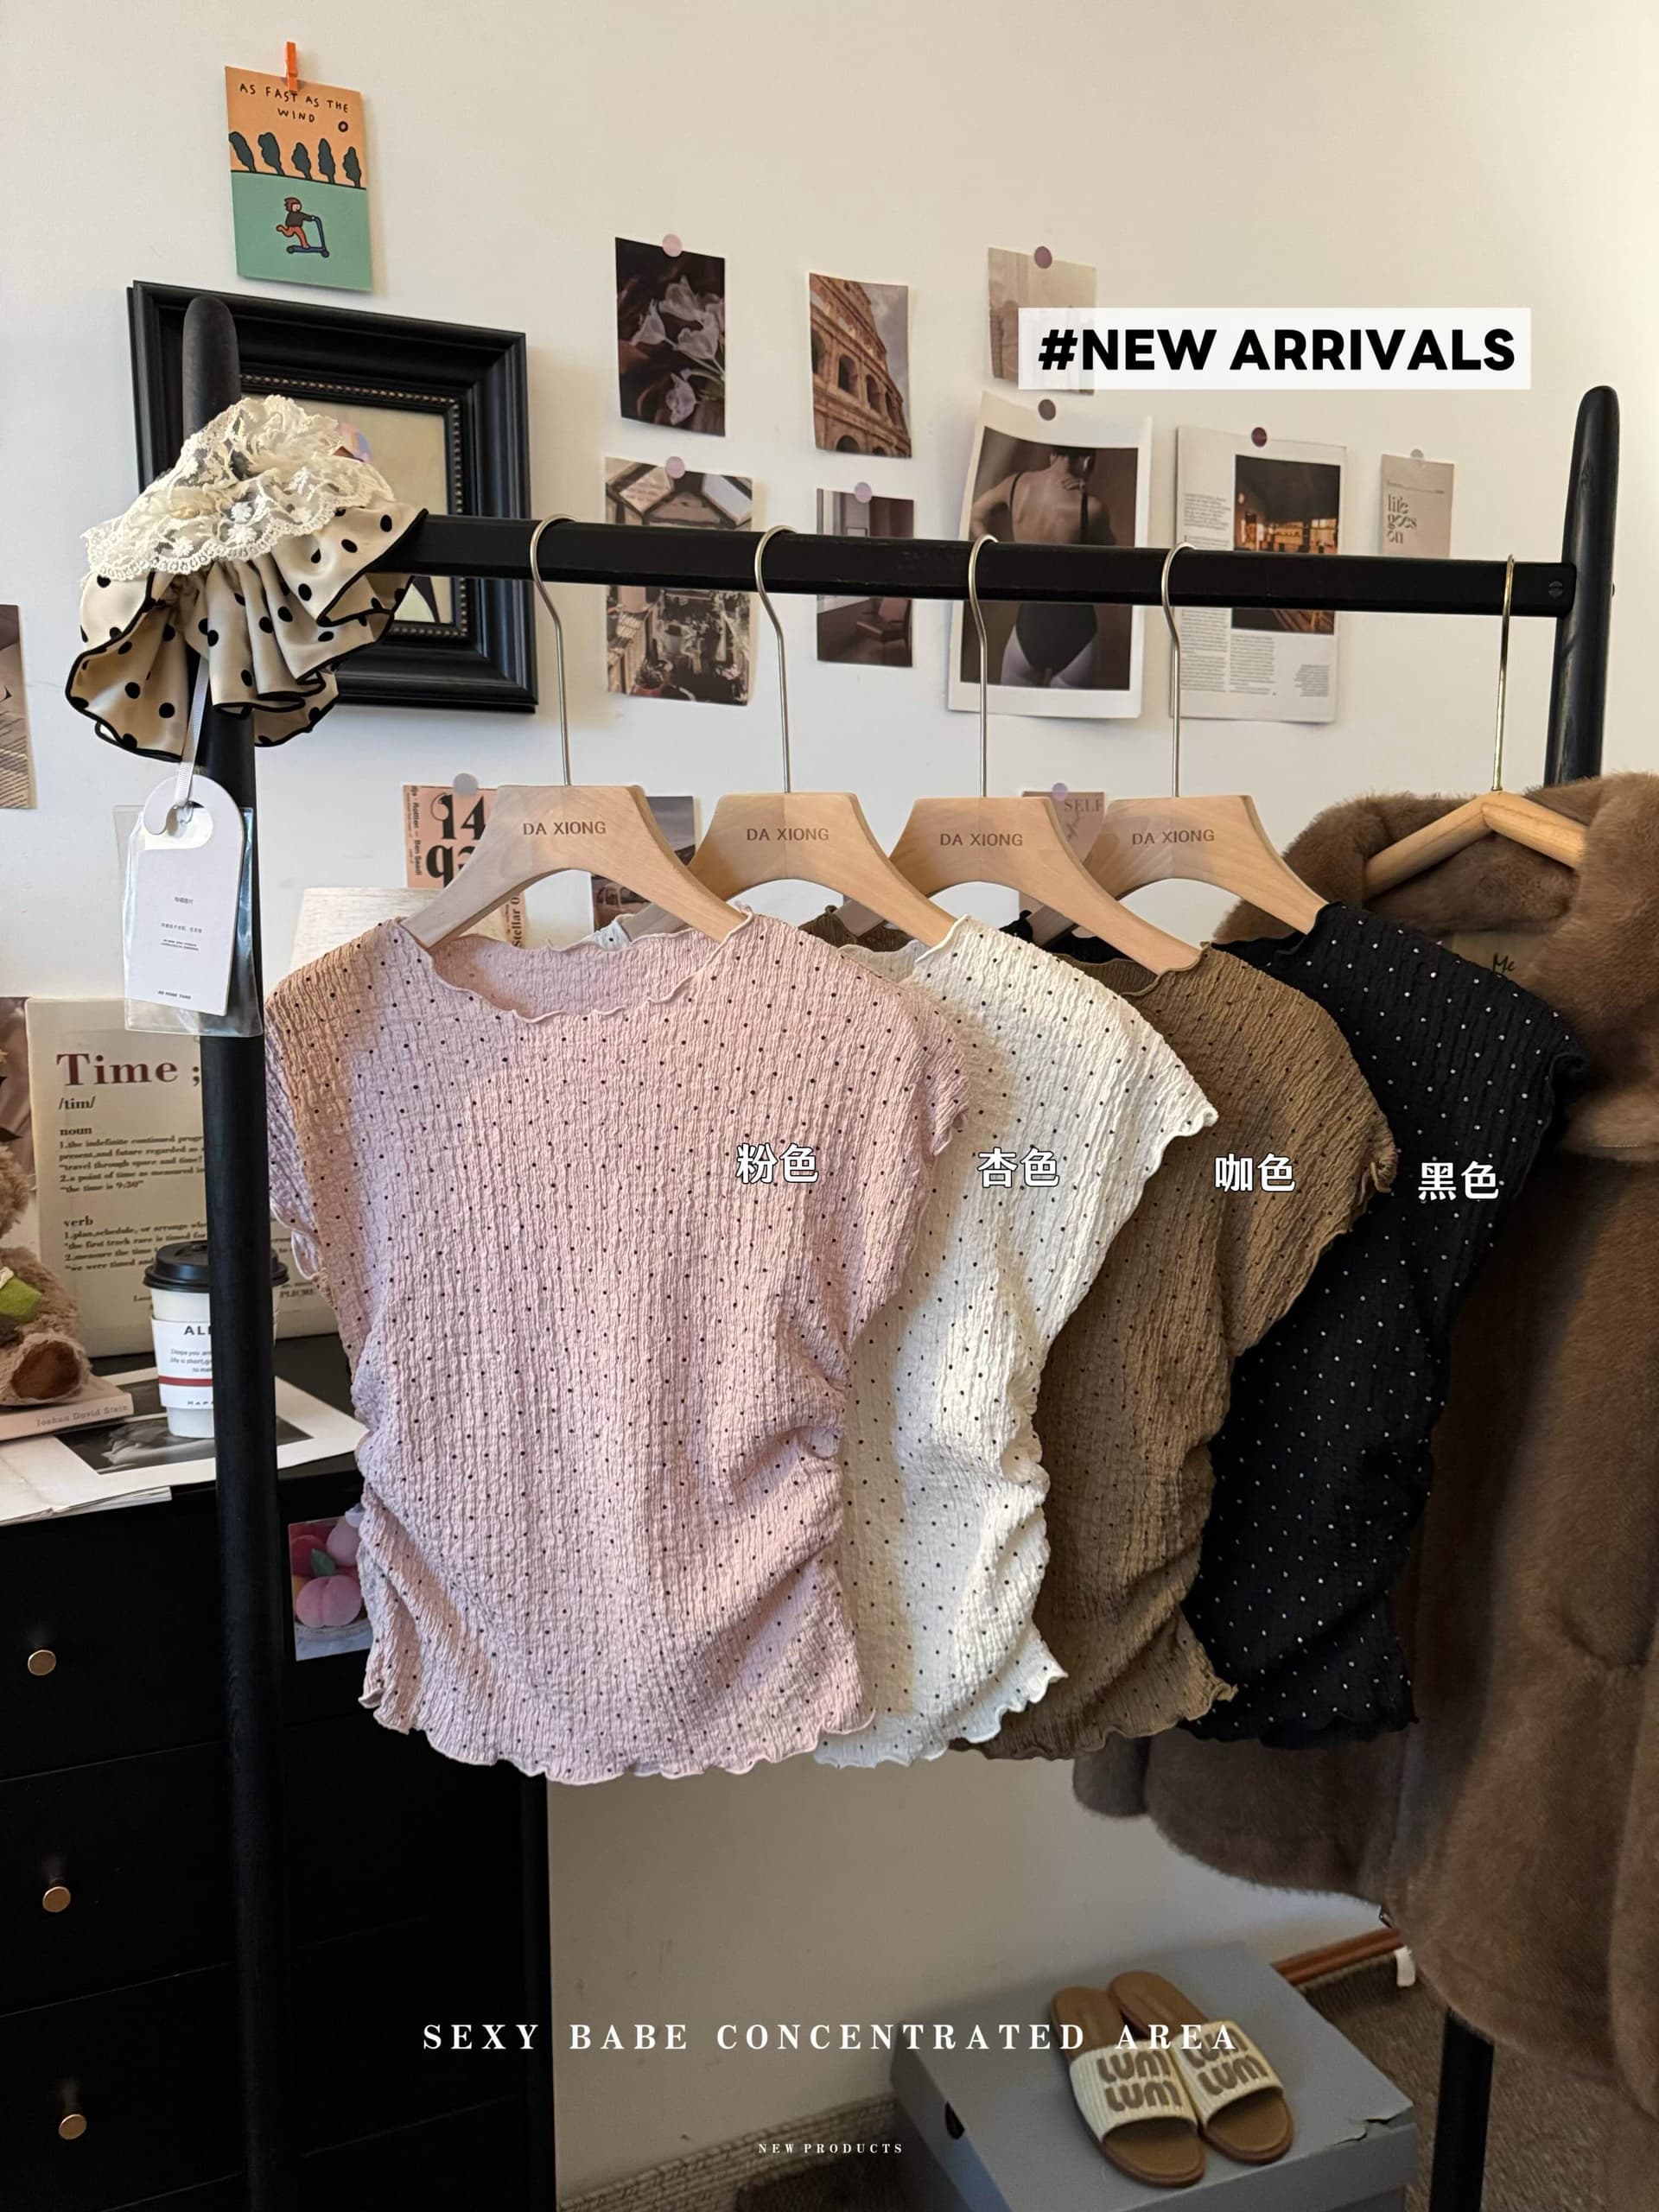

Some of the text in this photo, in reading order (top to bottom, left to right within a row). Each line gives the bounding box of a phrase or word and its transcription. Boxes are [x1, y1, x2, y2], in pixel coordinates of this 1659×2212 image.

[239, 83, 348, 113] AS FAST AS THE
[277, 107, 315, 123] WIND
[524, 821, 607, 835] DA XIONG
[747, 828, 830, 841] DA XIONG
[940, 833, 1023, 847] DA XIONG
[1132, 829, 1215, 845] DA XIONG
[56, 1052, 178, 1086] Time
[58, 1096, 96, 1110] /tim/
[60, 1127, 92, 1136] noun
[64, 1215, 93, 1227] verb
[183, 1325, 212, 1336] AL
